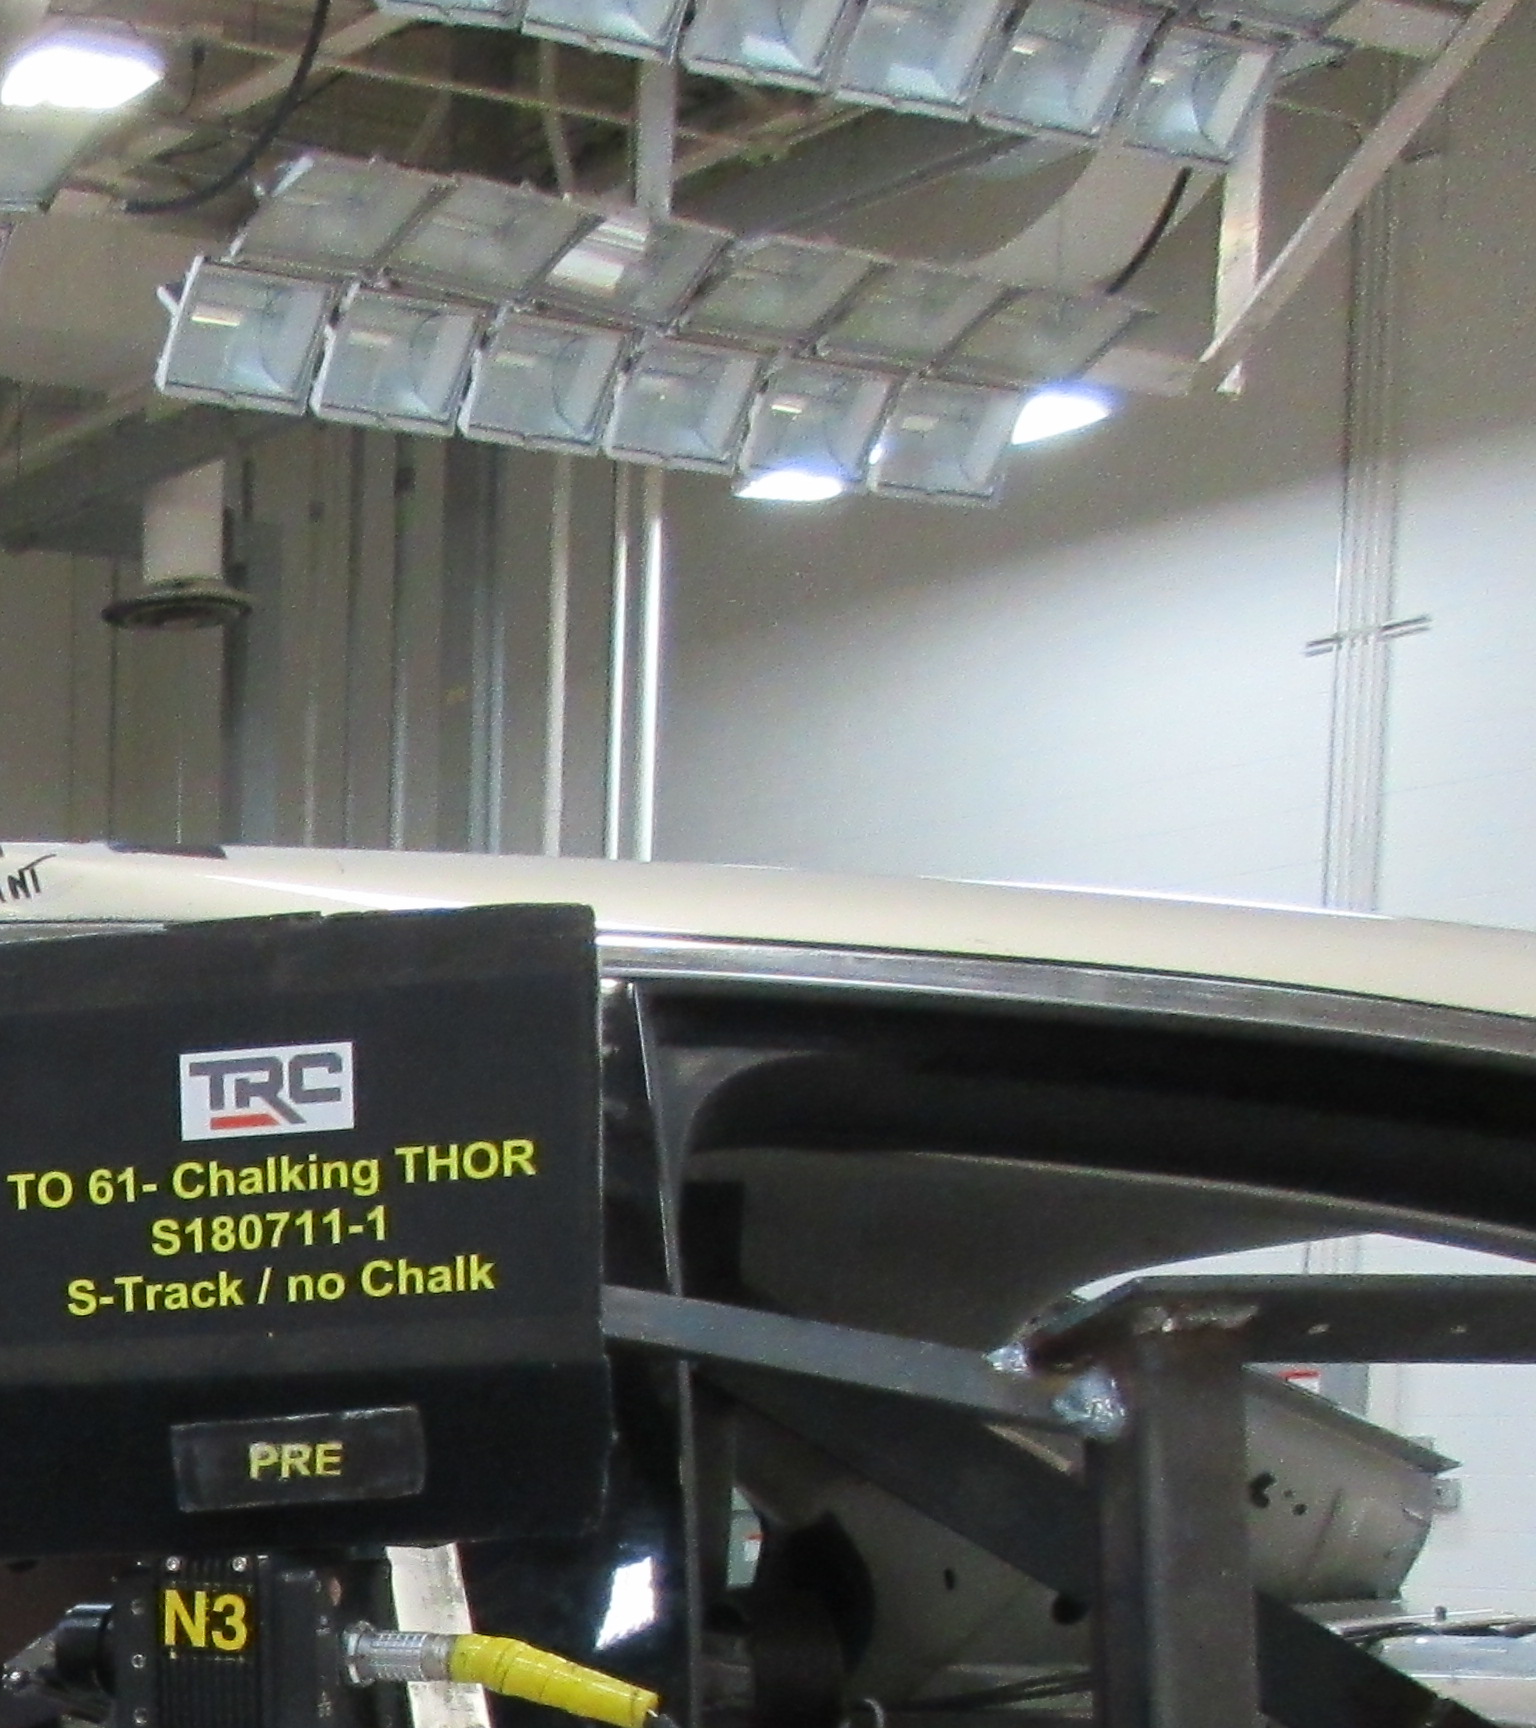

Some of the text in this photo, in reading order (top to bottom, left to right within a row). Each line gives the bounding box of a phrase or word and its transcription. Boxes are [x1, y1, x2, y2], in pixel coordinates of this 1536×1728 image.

[188, 1051, 344, 1125] TRC
[6, 1138, 538, 1209] TO 61- Chalking THOR
[151, 1204, 389, 1257] S180711-1
[67, 1252, 496, 1317] S-Track / no Chalk
[248, 1441, 344, 1480] PRE
[164, 1589, 248, 1651] N3
